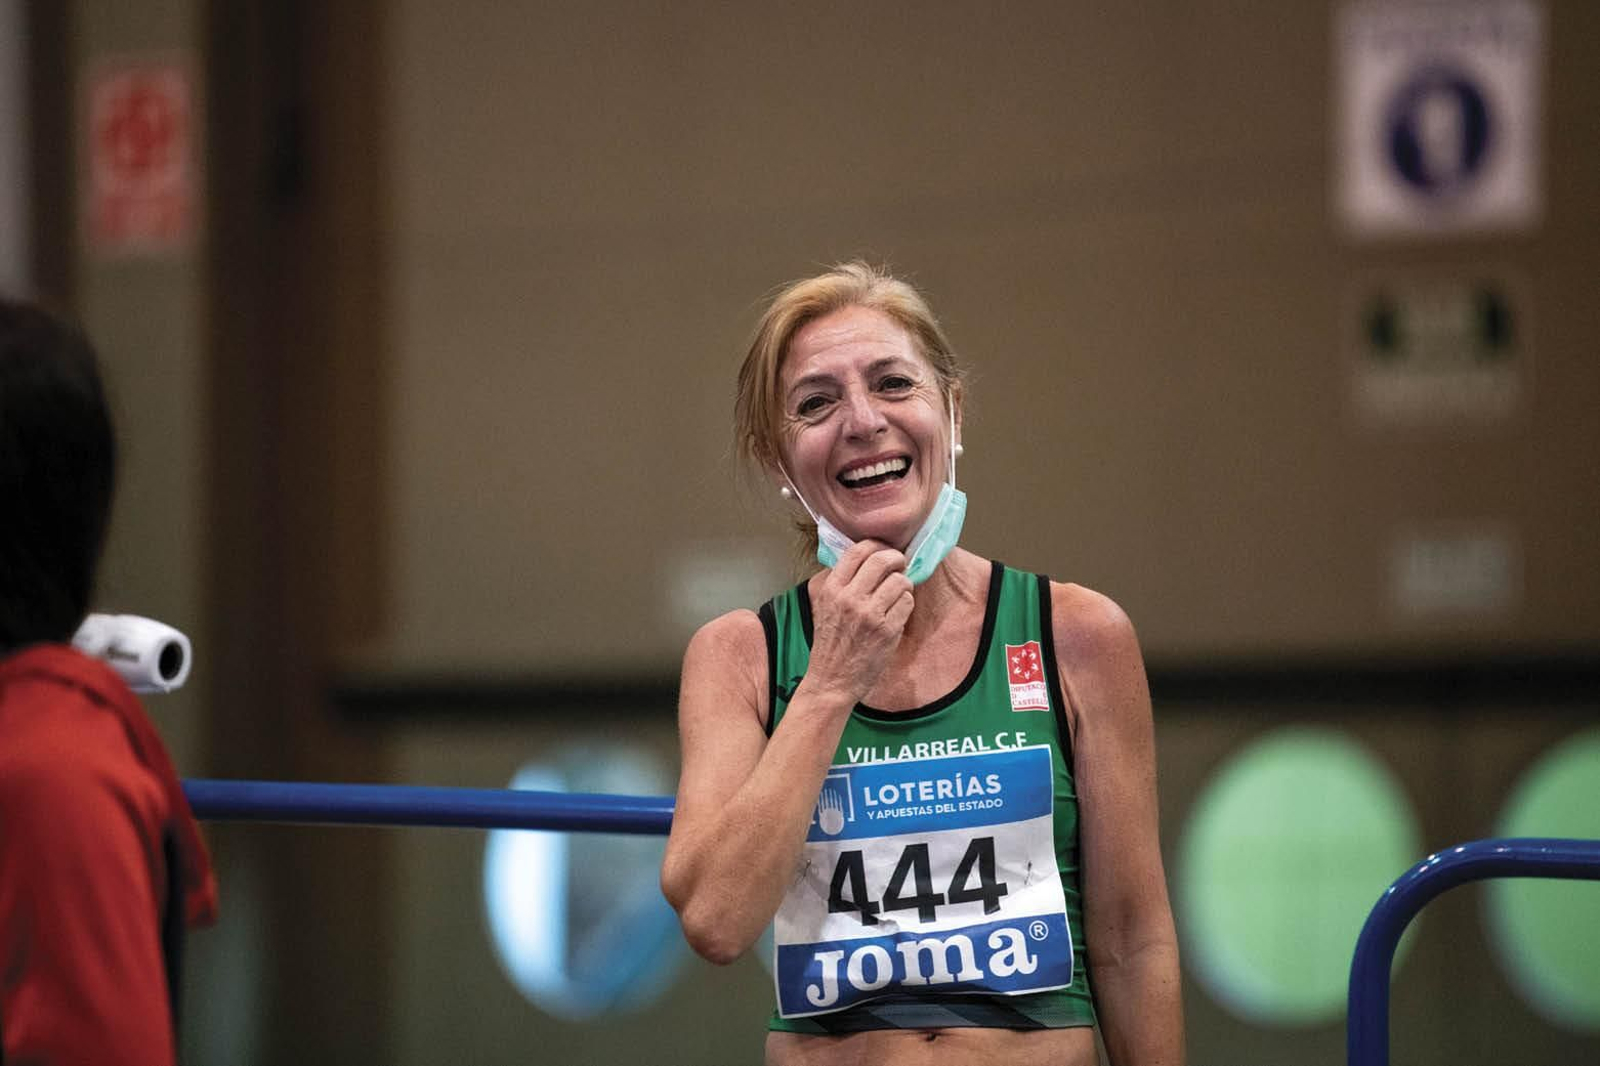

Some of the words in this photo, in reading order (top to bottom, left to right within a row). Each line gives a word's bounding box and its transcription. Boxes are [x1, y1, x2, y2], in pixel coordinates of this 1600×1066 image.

[847, 735, 990, 763] VILLARREAL
[863, 773, 1002, 806] LOTERÍAS
[867, 811, 876, 820] Y
[876, 805, 934, 819] APUESTAS
[935, 803, 956, 814] DEL
[958, 799, 1003, 811] ESTADO
[828, 836, 1008, 926] 444
